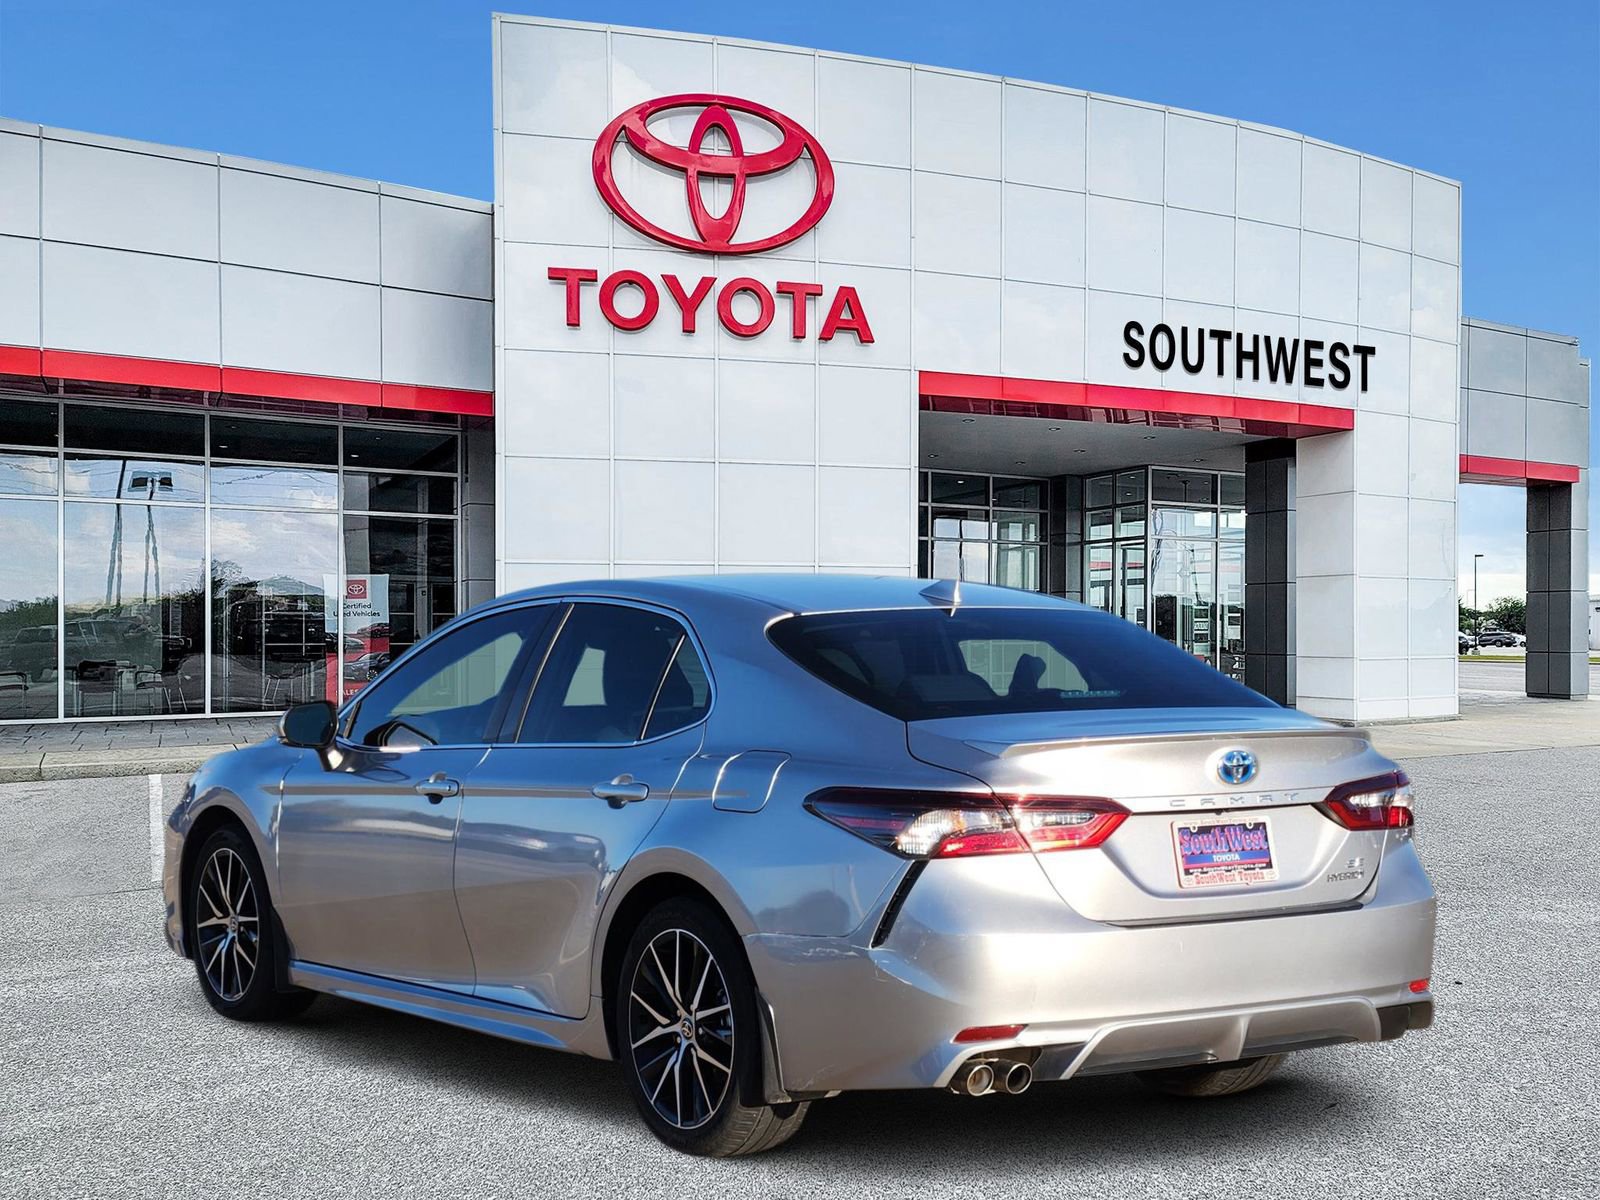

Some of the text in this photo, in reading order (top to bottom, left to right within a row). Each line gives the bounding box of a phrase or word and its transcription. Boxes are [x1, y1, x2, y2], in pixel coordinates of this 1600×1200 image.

[547, 266, 875, 344] TOYOTA
[1122, 320, 1376, 393] SOUTHWEST
[1169, 792, 1299, 807] CAMRY
[1212, 853, 1241, 863] TOYOTA
[1237, 869, 1265, 883] Toyota
[1327, 869, 1364, 882] HYBRID
